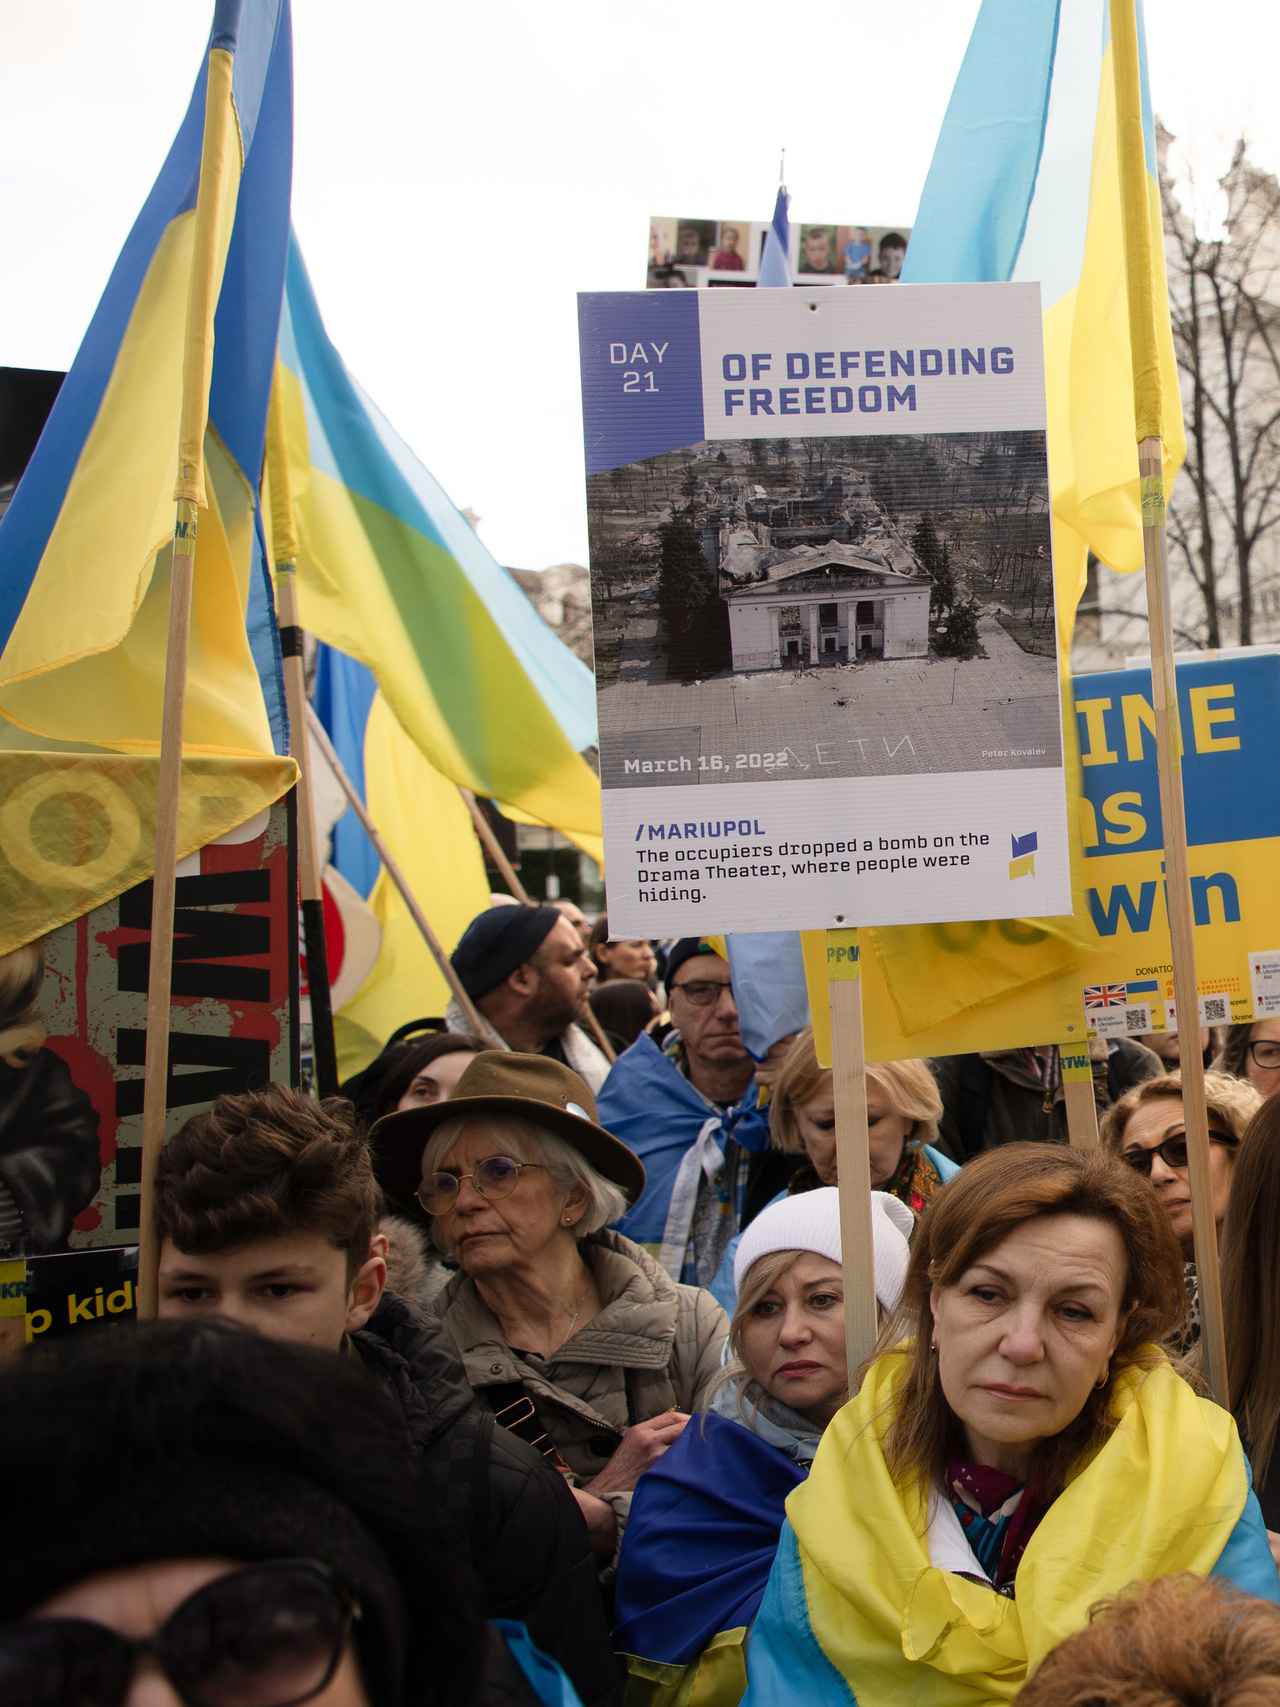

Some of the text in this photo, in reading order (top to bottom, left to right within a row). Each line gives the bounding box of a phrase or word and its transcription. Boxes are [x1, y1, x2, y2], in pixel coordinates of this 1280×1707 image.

[609, 342, 670, 365] DAY
[721, 346, 1015, 381] OF DEFENDING
[622, 370, 660, 393] 21
[724, 384, 918, 416] FREEDOM
[624, 752, 789, 774] March 16, 2022
[982, 747, 1046, 758] Peter Kovalev
[634, 819, 766, 842] /MARIUPOL
[636, 832, 990, 863] The occupiers dropped a bomb on the
[637, 854, 971, 883] Drama Theater, where people were
[638, 886, 707, 903] hiding.
[67, 1280, 138, 1325] kid
